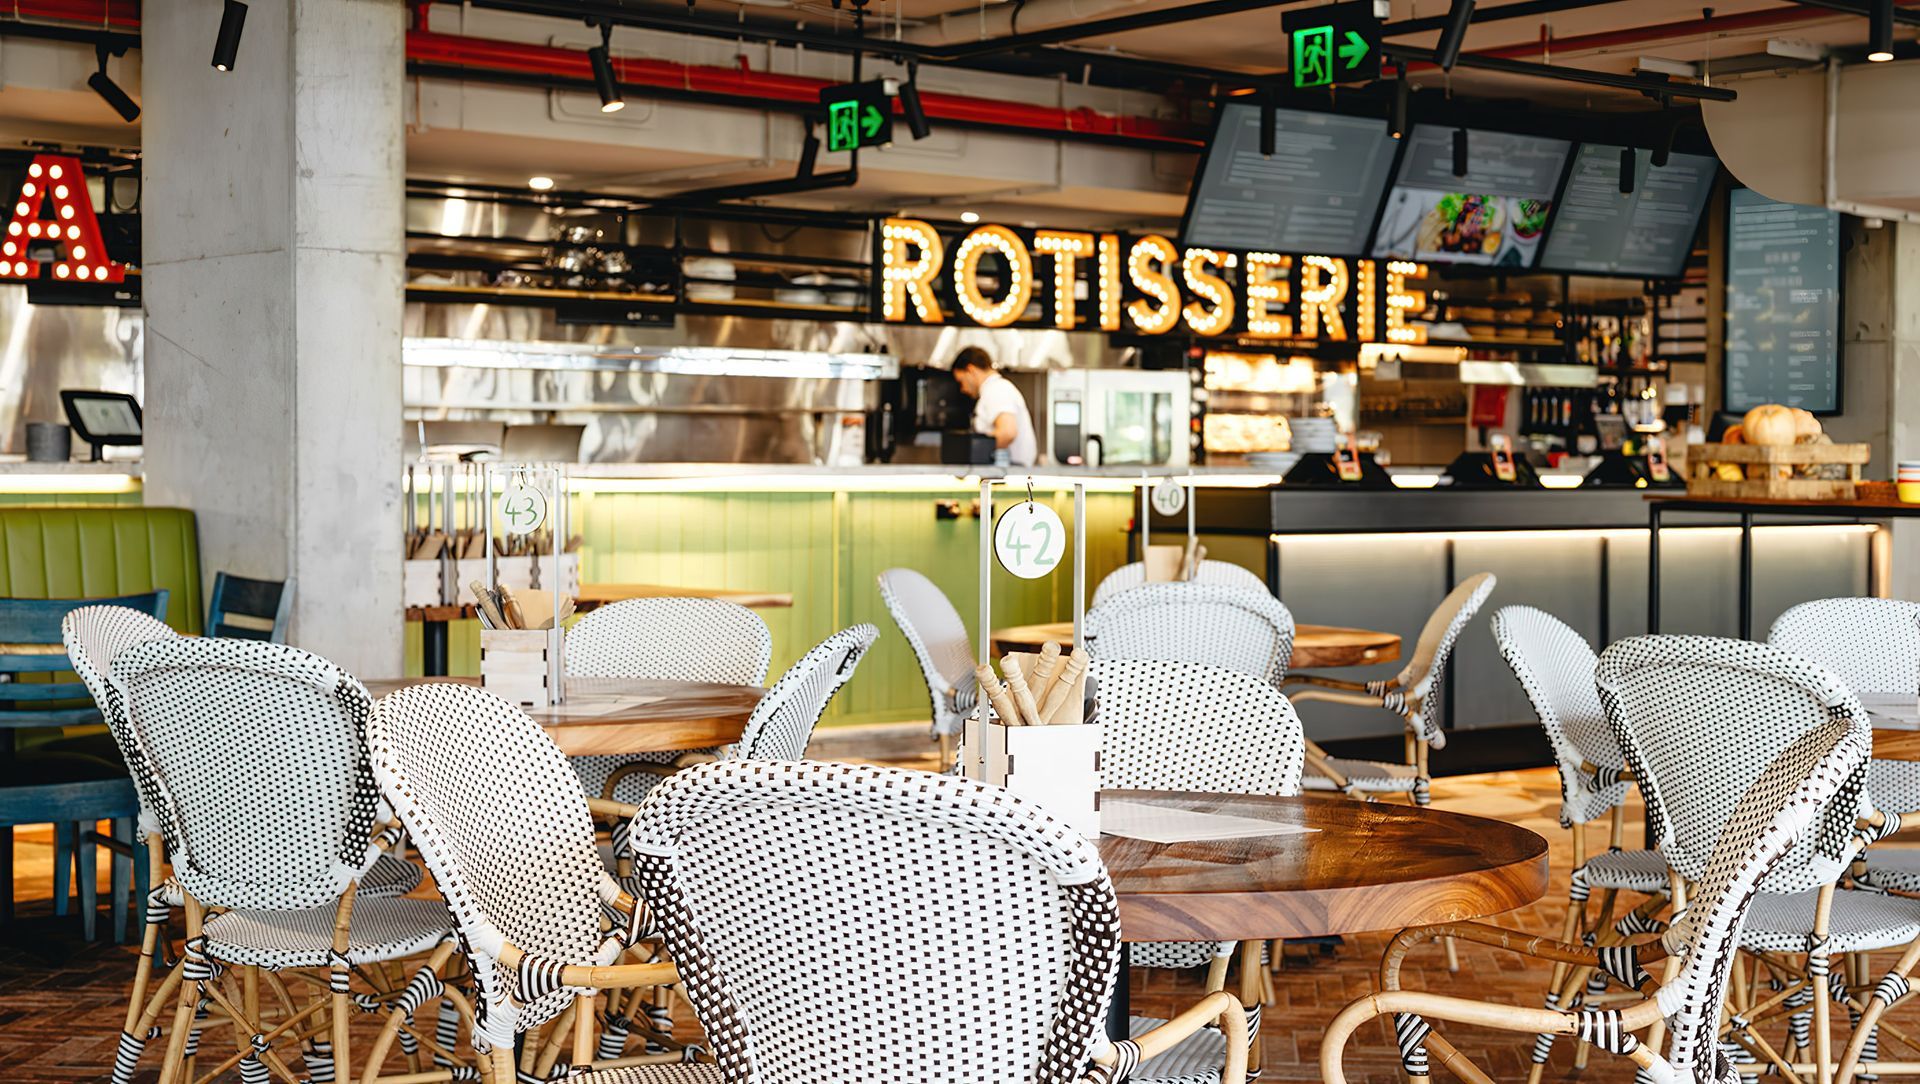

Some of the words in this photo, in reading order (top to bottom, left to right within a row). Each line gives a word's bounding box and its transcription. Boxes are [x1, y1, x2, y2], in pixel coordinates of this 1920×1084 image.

[0, 154, 126, 283] A
[882, 217, 1428, 343] ROTISSERIE
[505, 497, 538, 526] 43
[1158, 489, 1179, 508] 40
[1005, 520, 1055, 566] 42
